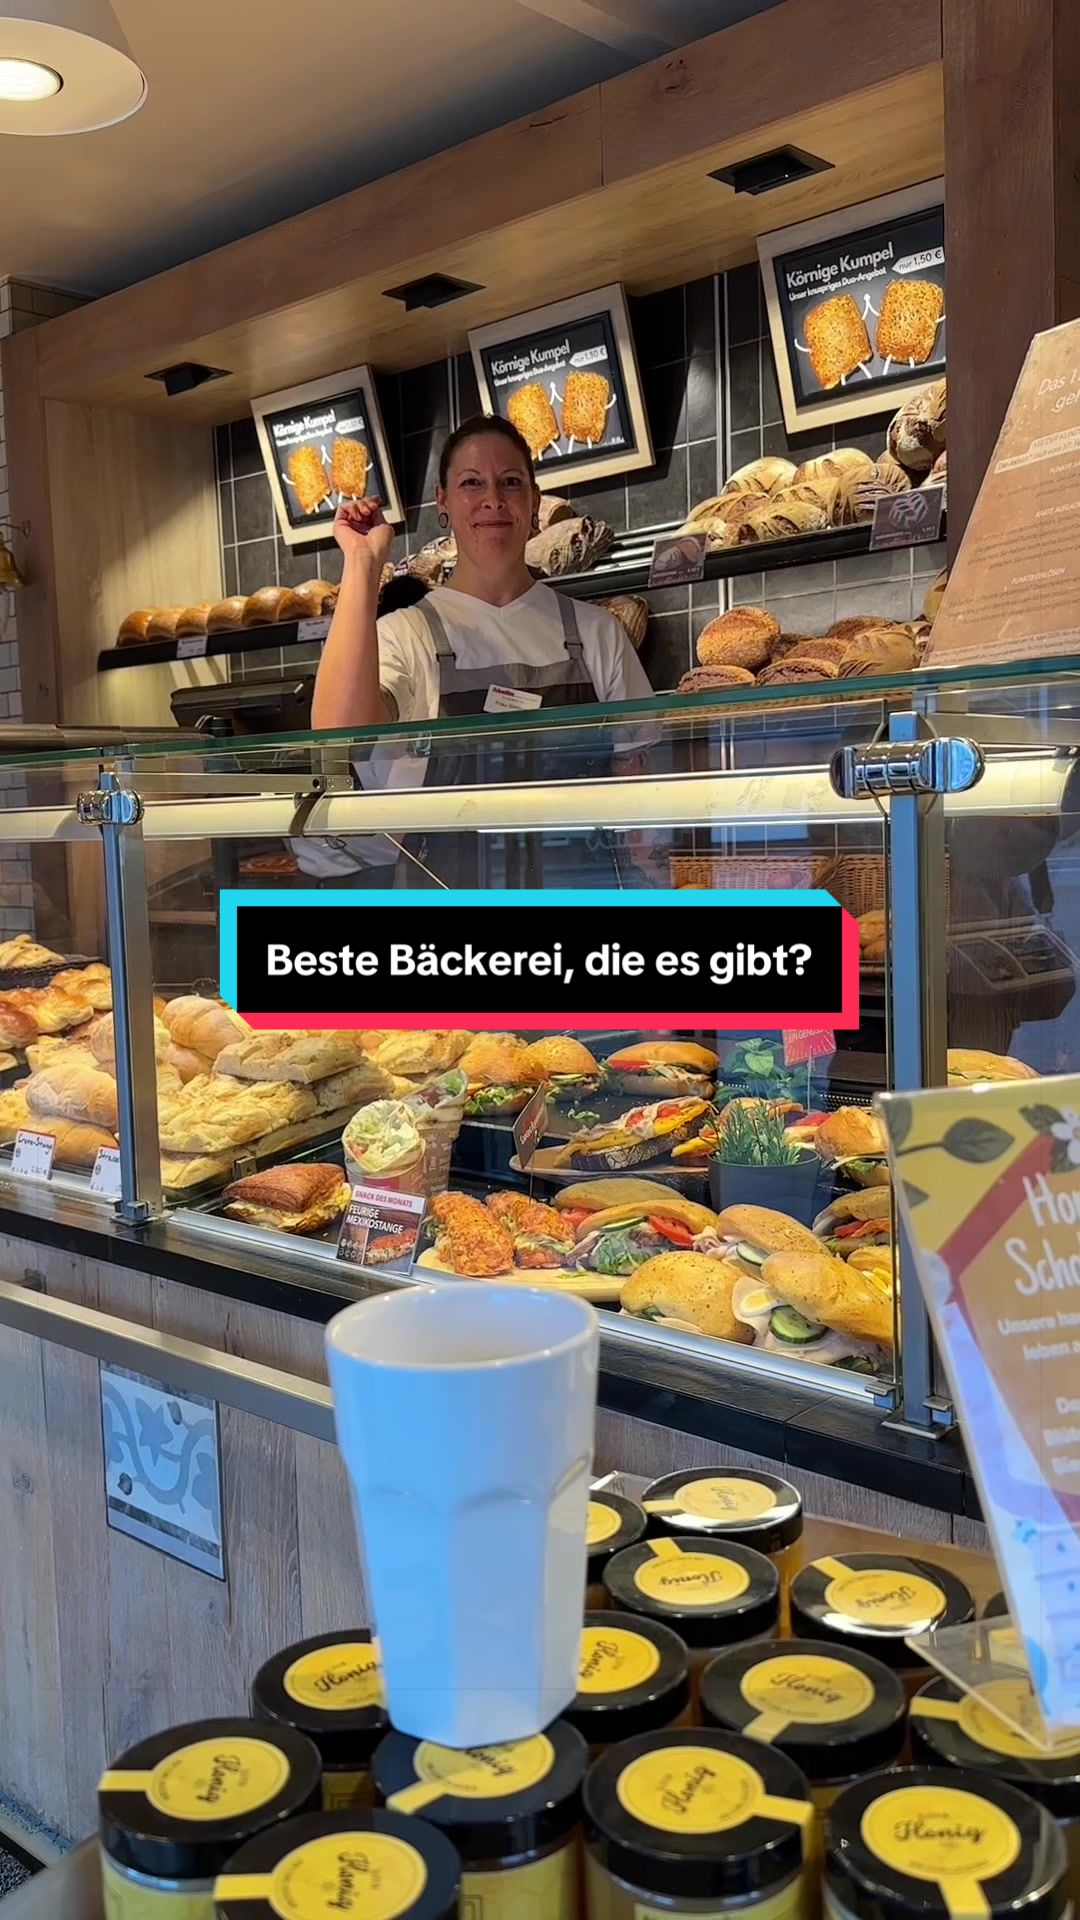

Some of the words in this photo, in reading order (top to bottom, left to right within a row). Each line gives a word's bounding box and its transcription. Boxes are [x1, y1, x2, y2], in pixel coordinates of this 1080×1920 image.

[786, 264, 838, 288] Körnige
[840, 242, 894, 269] Kumpel
[913, 252, 931, 266] 1,50
[789, 291, 807, 301] Unser
[807, 282, 841, 296] knuspriges
[842, 266, 887, 286] Duo-Angebot
[491, 355, 531, 375] Körnige
[530, 338, 571, 363] Kumpel
[1038, 376, 1067, 396] Das
[375, 1194, 387, 1203] DES
[349, 1204, 380, 1219] FEURIGE
[346, 1214, 404, 1234] MEXIKOSTANGE
[660, 1570, 723, 1587] Honig
[770, 1672, 842, 1704] Honig
[661, 1763, 717, 1816] Honig
[894, 1819, 983, 1843] Honig
[326, 1851, 370, 1912] Honig
